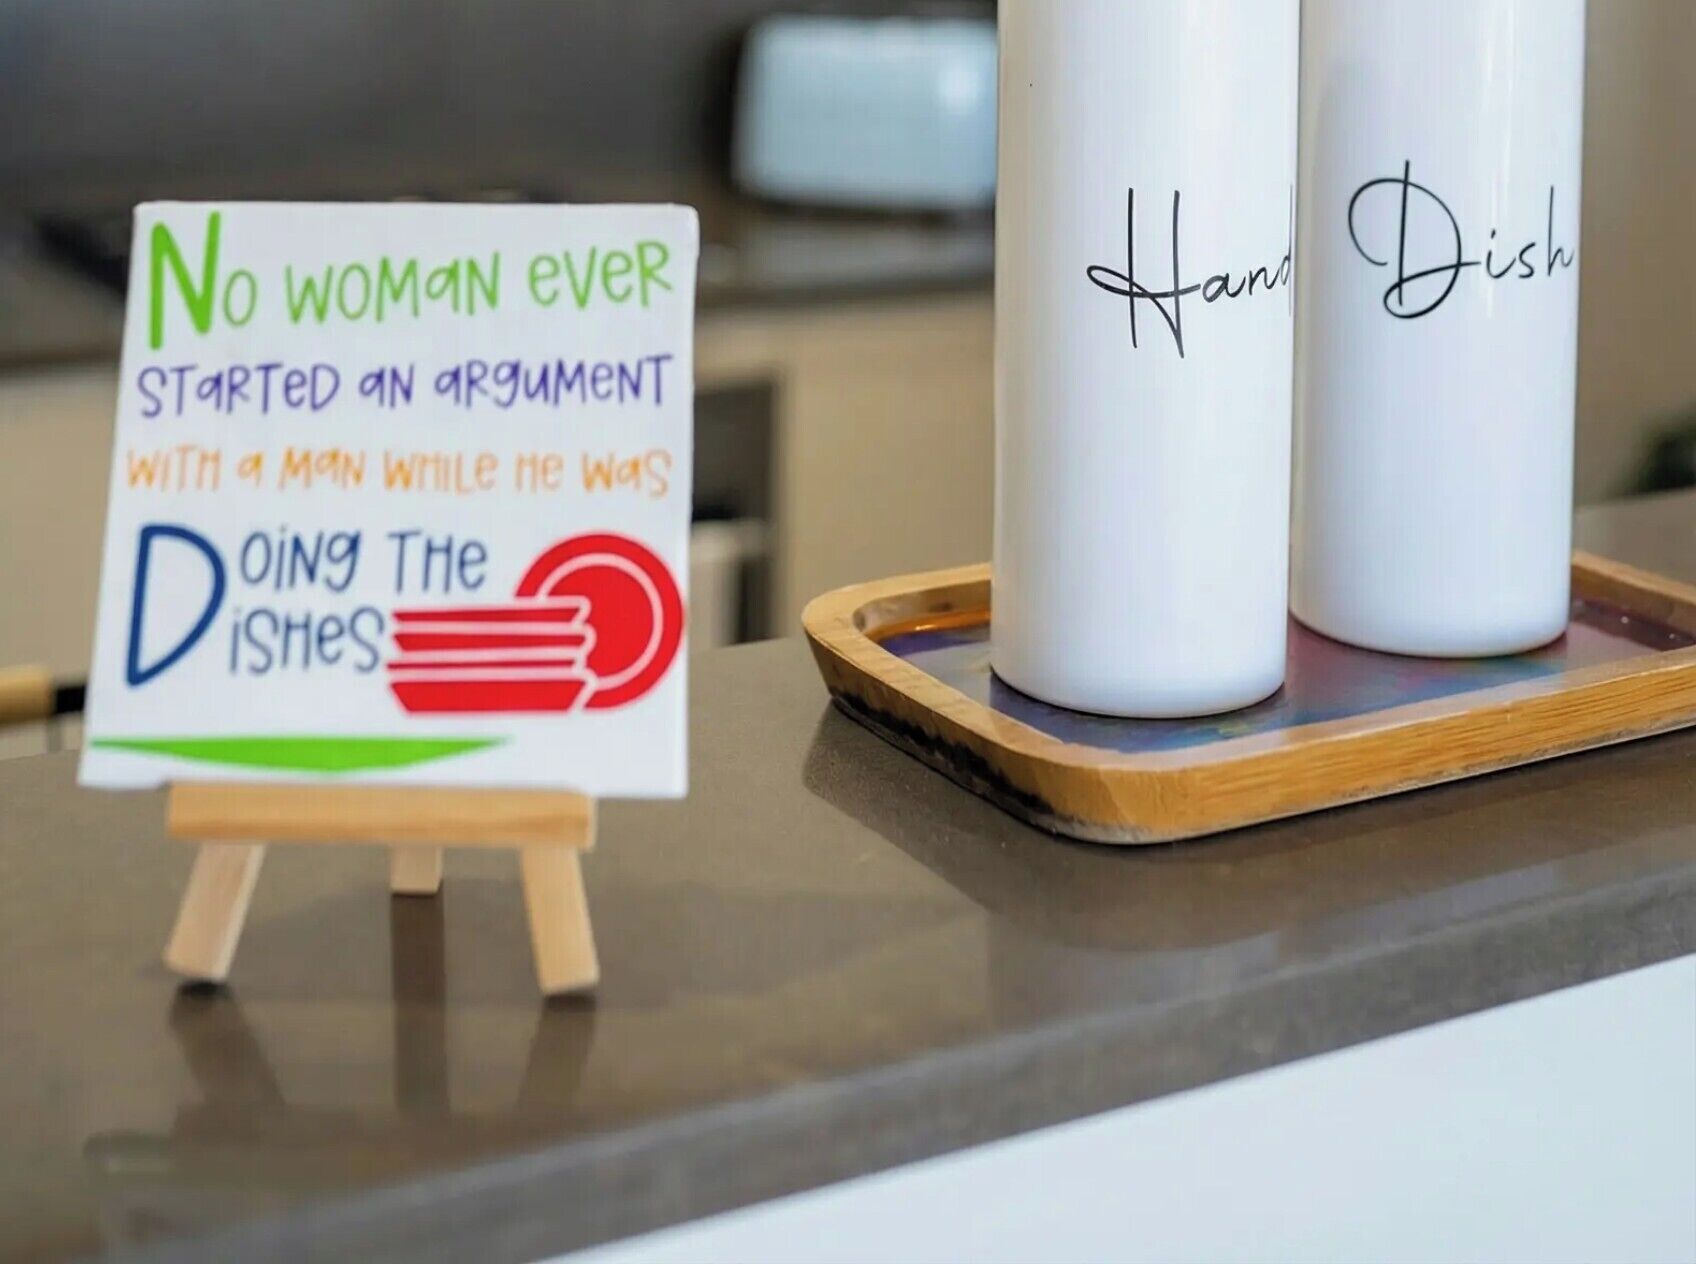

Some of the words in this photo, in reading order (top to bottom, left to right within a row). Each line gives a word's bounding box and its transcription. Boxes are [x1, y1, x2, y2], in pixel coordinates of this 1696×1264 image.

[148, 211, 257, 352] No
[1086, 187, 1294, 358] Hand
[1348, 159, 1575, 319] Dish
[127, 444, 221, 492] WITH
[236, 449, 263, 487] a
